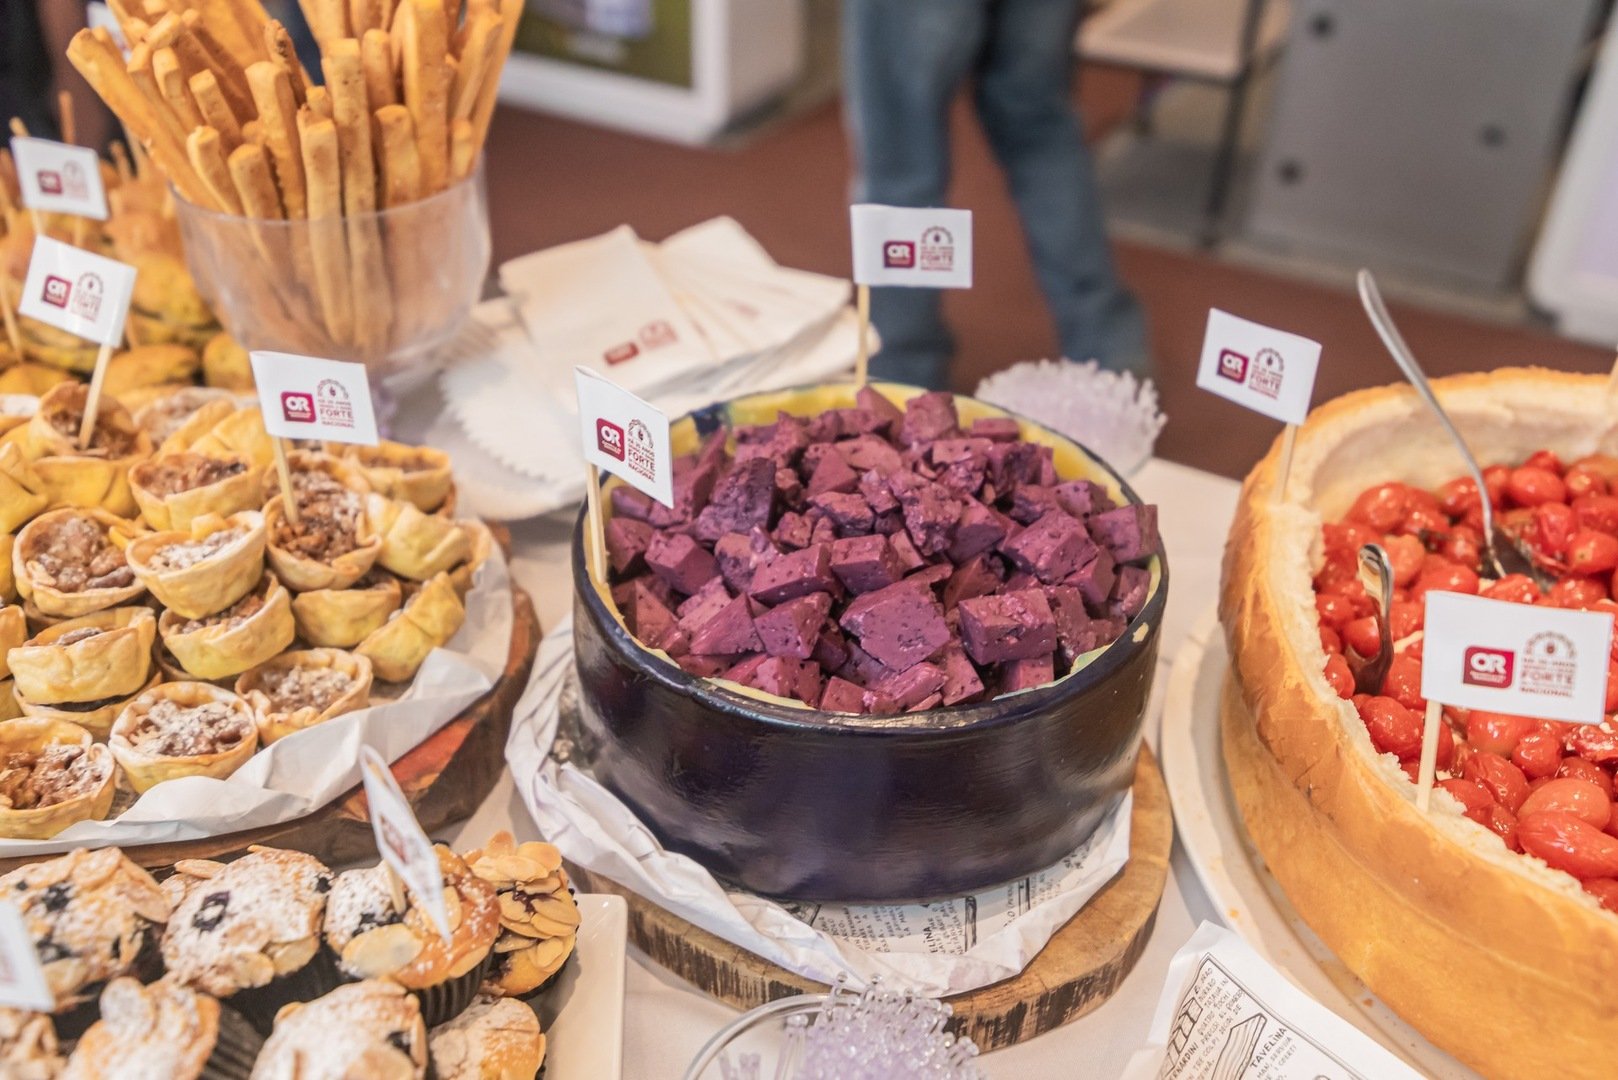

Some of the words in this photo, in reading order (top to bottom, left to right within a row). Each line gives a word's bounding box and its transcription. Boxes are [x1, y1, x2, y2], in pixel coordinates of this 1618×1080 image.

[285, 397, 311, 412] OR
[320, 408, 353, 418] FORTE
[601, 425, 621, 447] OR
[628, 449, 656, 471] FORTE
[1470, 652, 1507, 674] OR
